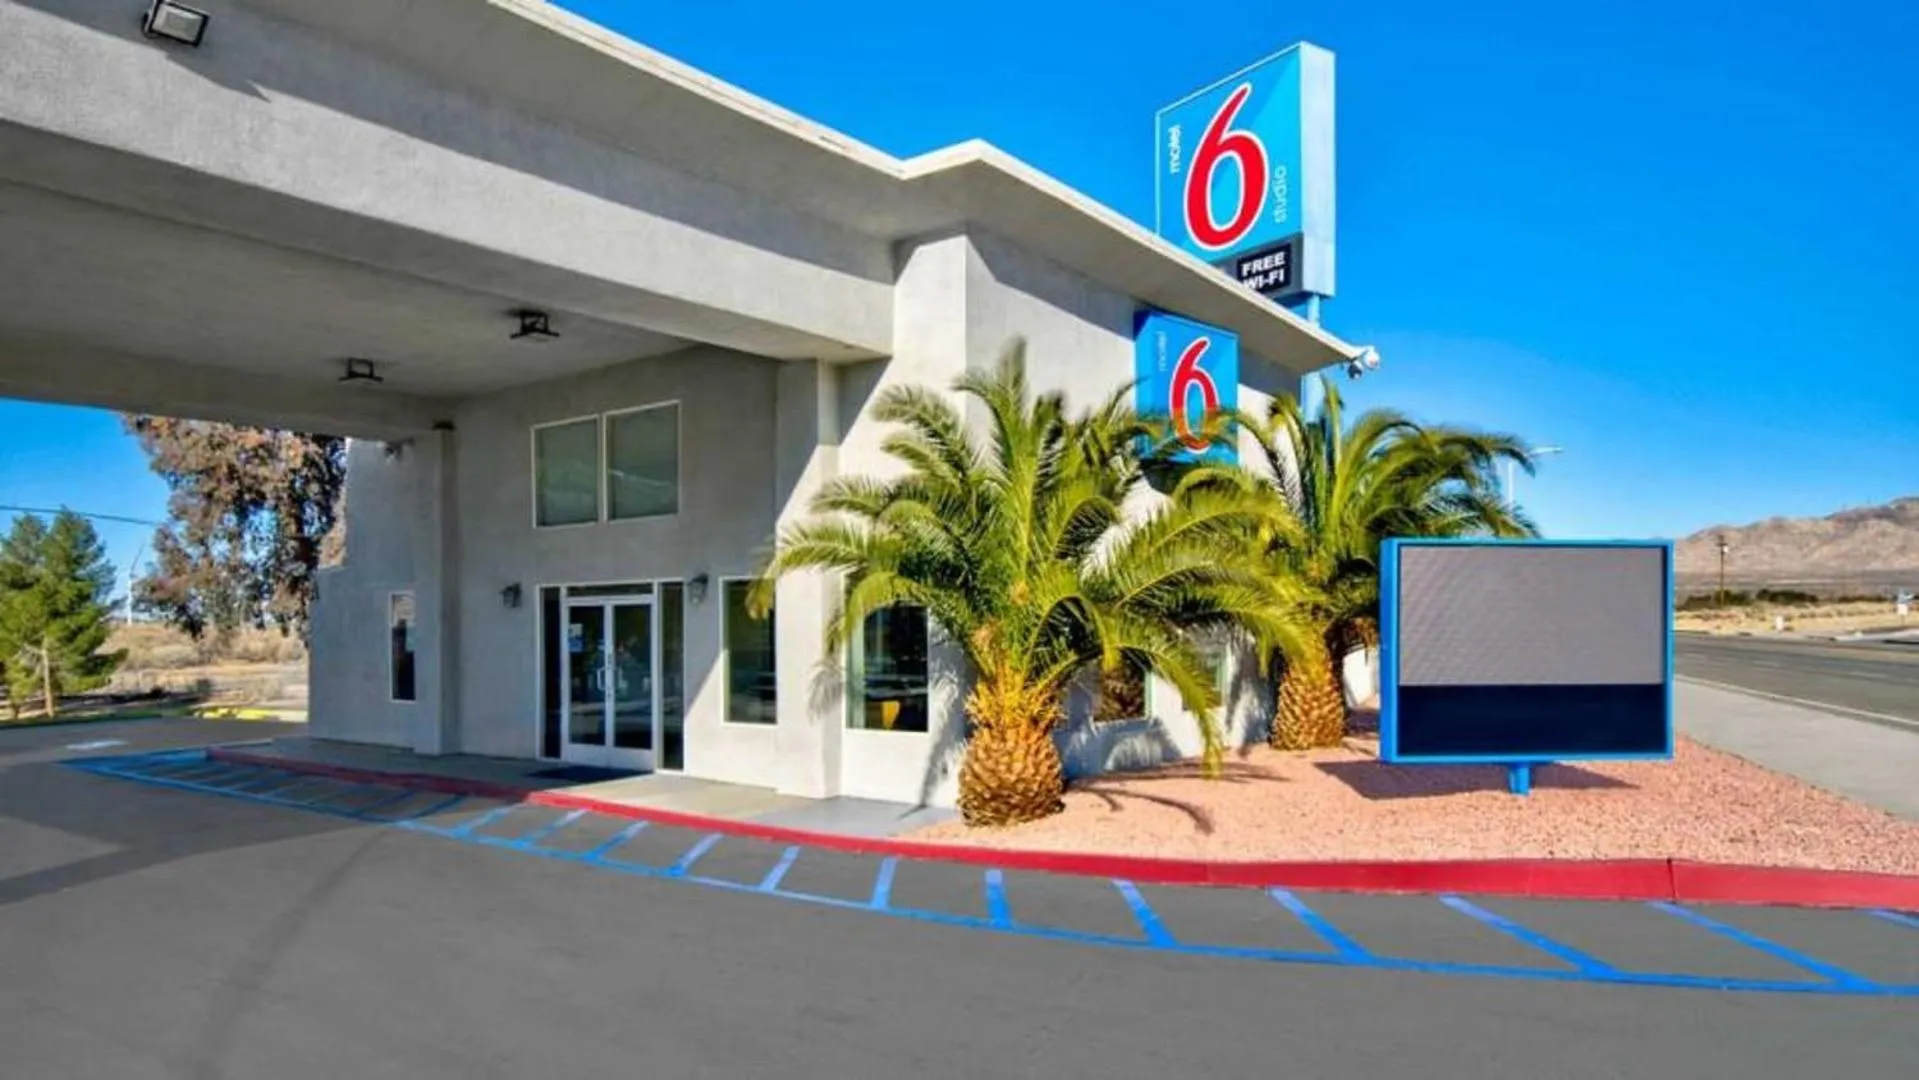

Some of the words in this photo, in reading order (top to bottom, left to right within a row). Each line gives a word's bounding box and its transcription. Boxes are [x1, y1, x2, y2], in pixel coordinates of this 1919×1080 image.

[1169, 124, 1182, 174] motel
[1184, 82, 1270, 251] 6
[1272, 164, 1287, 225] studio
[1240, 251, 1286, 277] FREE
[1243, 269, 1286, 292] WI-FI
[1169, 336, 1220, 454] 6
